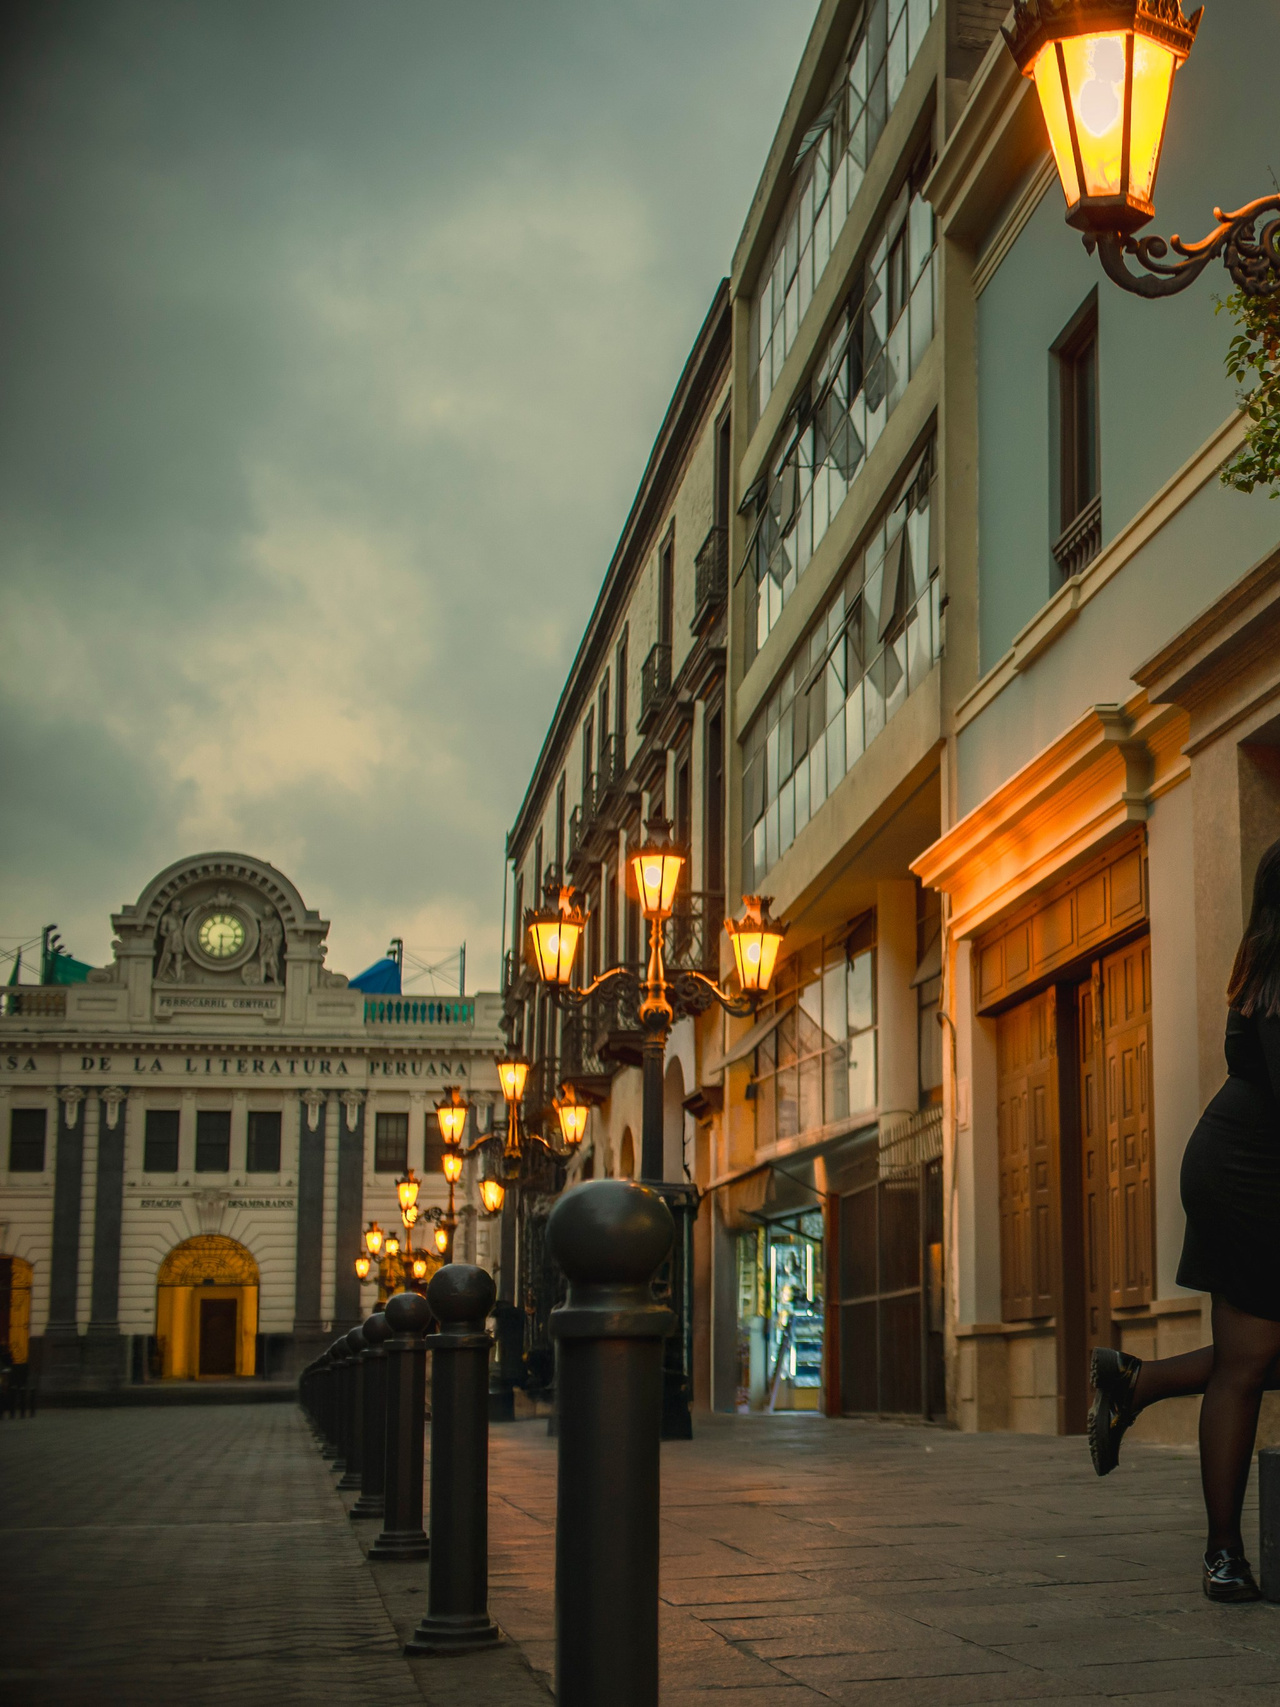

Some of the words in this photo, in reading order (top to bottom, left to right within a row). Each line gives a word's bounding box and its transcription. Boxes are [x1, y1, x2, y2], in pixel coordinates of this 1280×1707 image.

[160, 998, 227, 1008] FERROCARRIL
[232, 999, 276, 1009] CENTRAL
[0, 1056, 37, 1071] SA
[80, 1057, 112, 1071] DE
[133, 1057, 163, 1072] LA
[185, 1058, 349, 1075] LITERATURA
[369, 1060, 468, 1076] PERUANA
[228, 1200, 294, 1208] DESAMPARADOS
